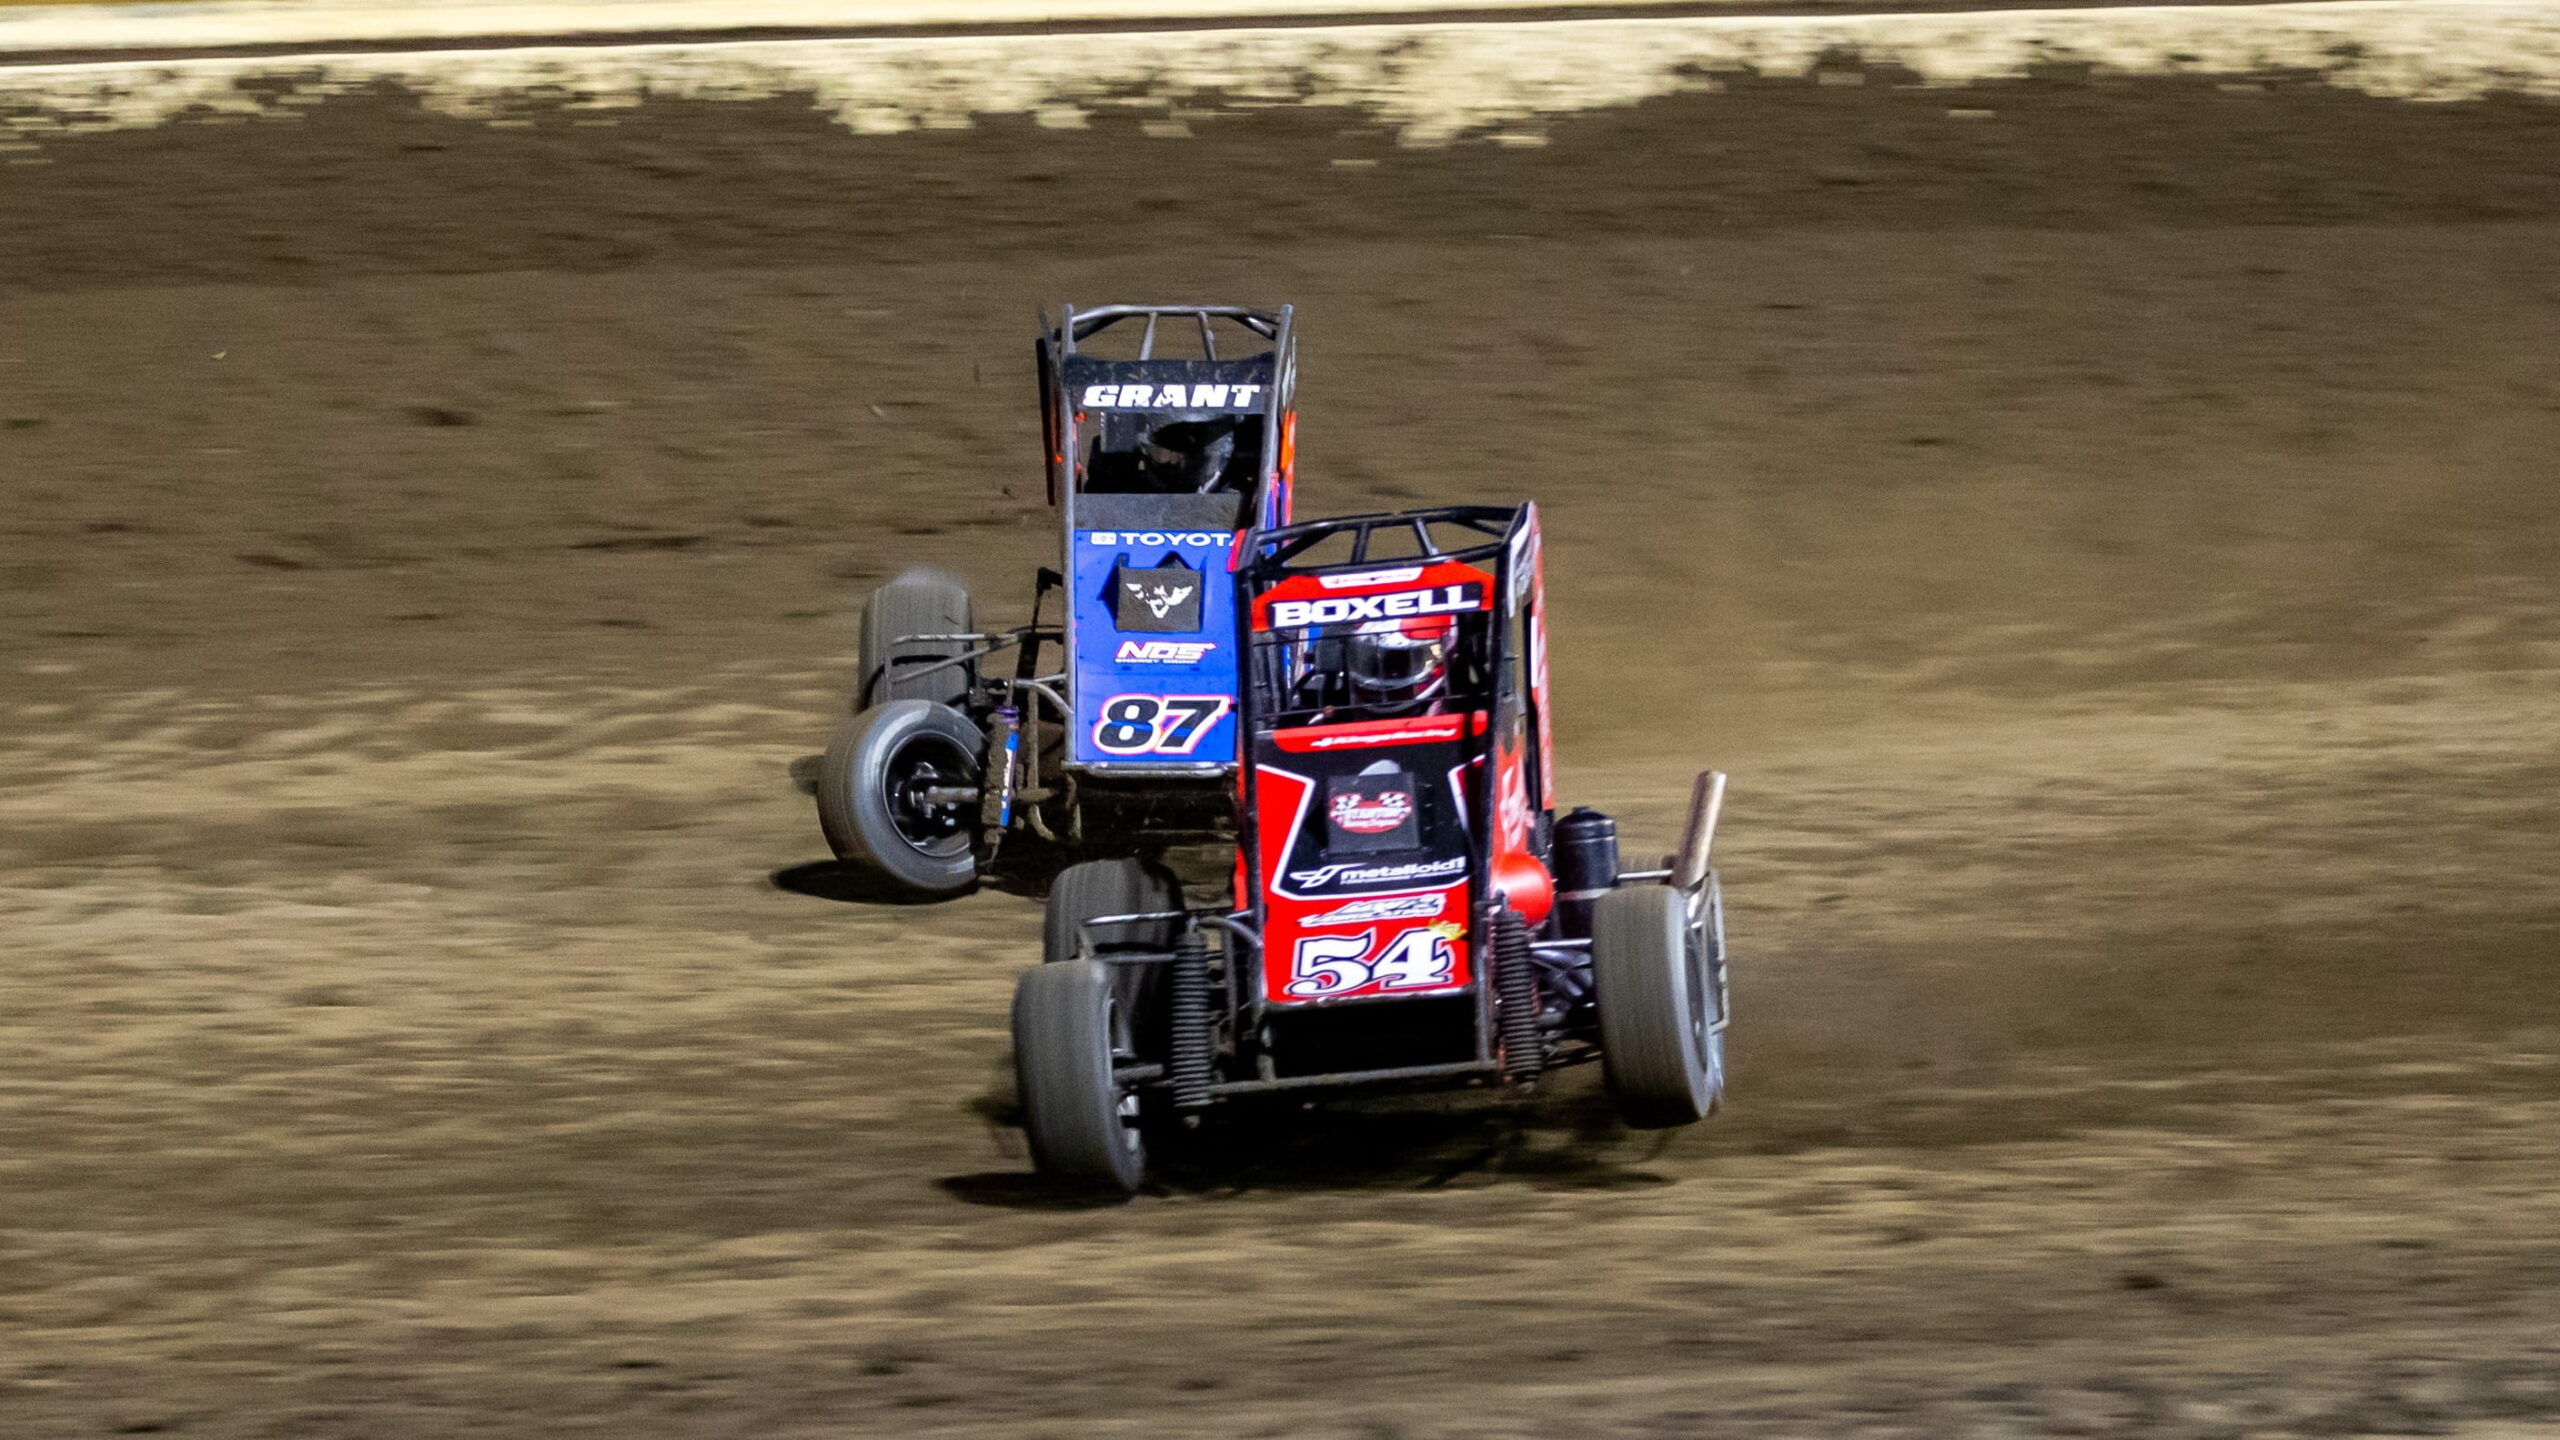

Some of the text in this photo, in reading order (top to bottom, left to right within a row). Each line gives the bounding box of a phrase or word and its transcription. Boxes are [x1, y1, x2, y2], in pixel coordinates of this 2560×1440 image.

[1082, 384, 1261, 408] GRANT
[1120, 532, 1236, 547] TOYOT
[1271, 585, 1481, 628] BOXELL
[1115, 641, 1218, 660] NOS
[1092, 693, 1236, 756] 87
[1283, 926, 1456, 997] 54
